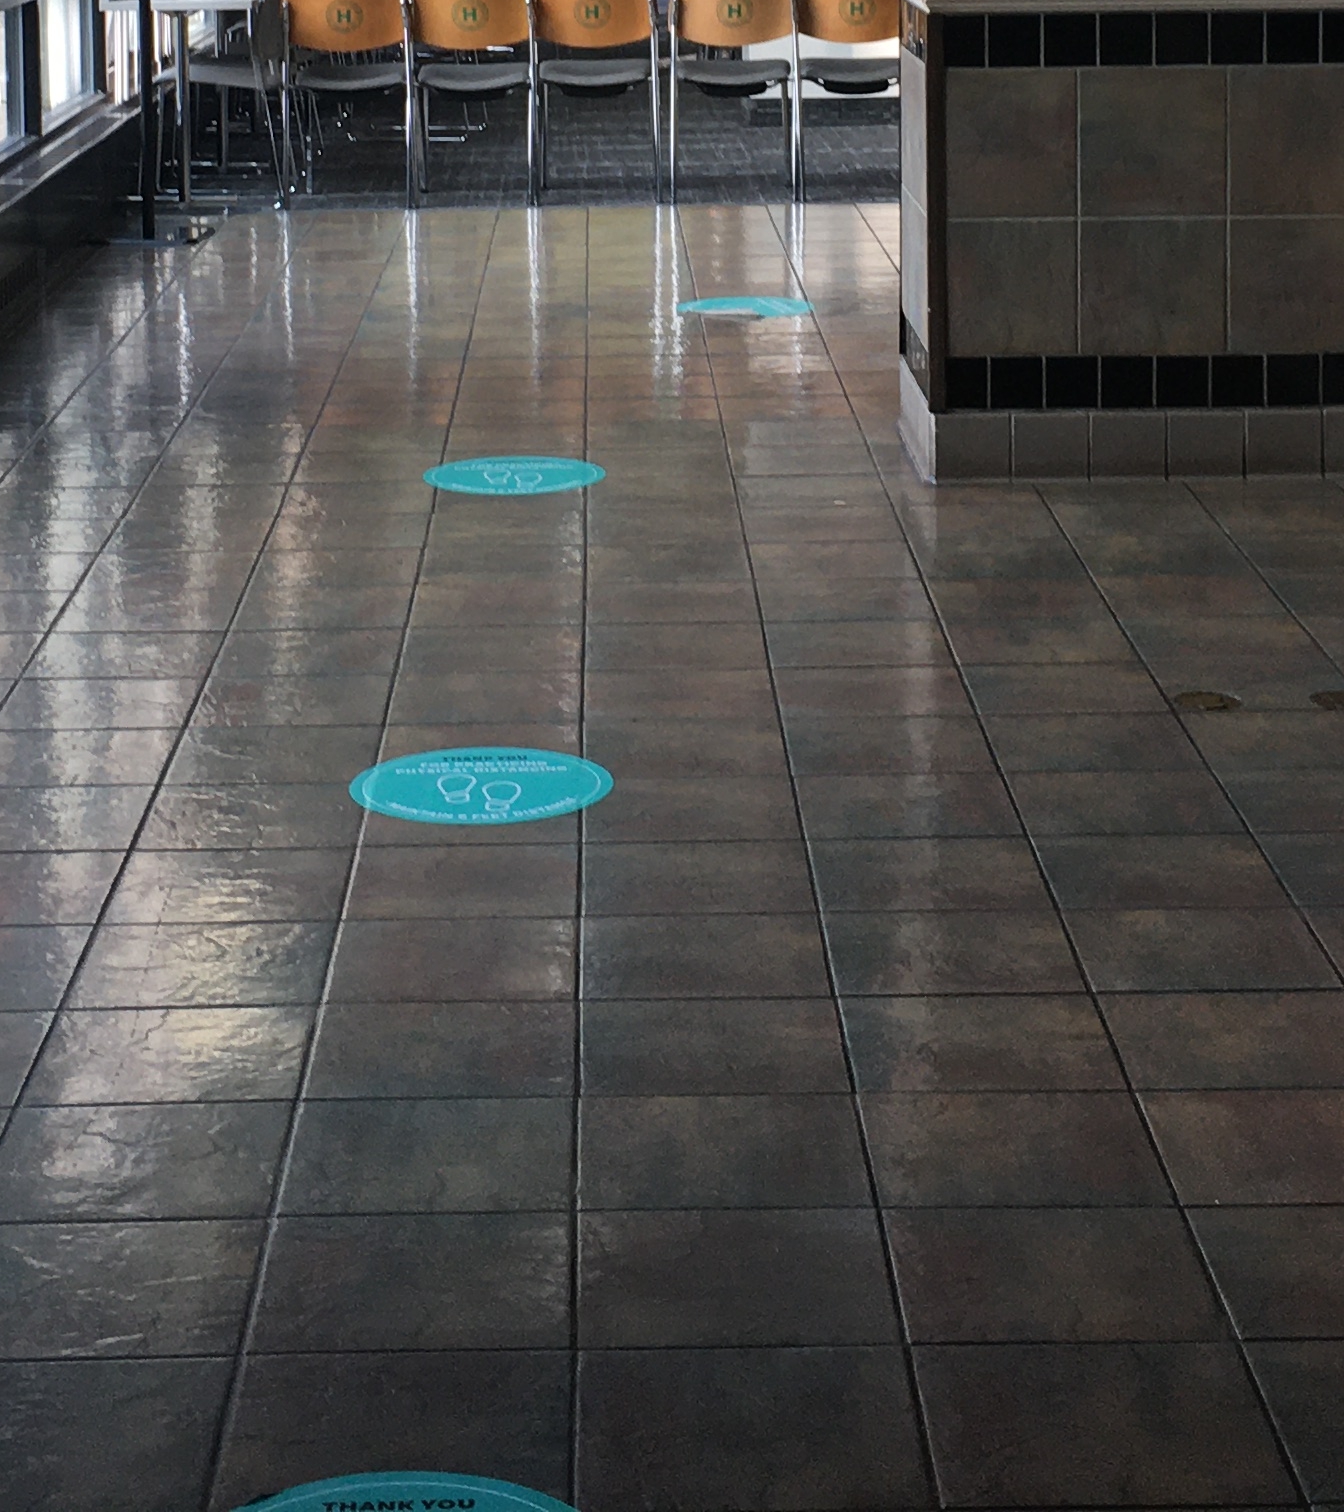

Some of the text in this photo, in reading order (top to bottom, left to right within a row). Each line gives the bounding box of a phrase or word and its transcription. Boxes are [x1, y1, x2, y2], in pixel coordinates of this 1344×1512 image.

[463, 7, 477, 21] H
[585, 5, 599, 19] H
[727, 3, 741, 18] H
[850, 1, 864, 16] H
[337, 9, 351, 23] H
[322, 1497, 476, 1512] THANK YOU
